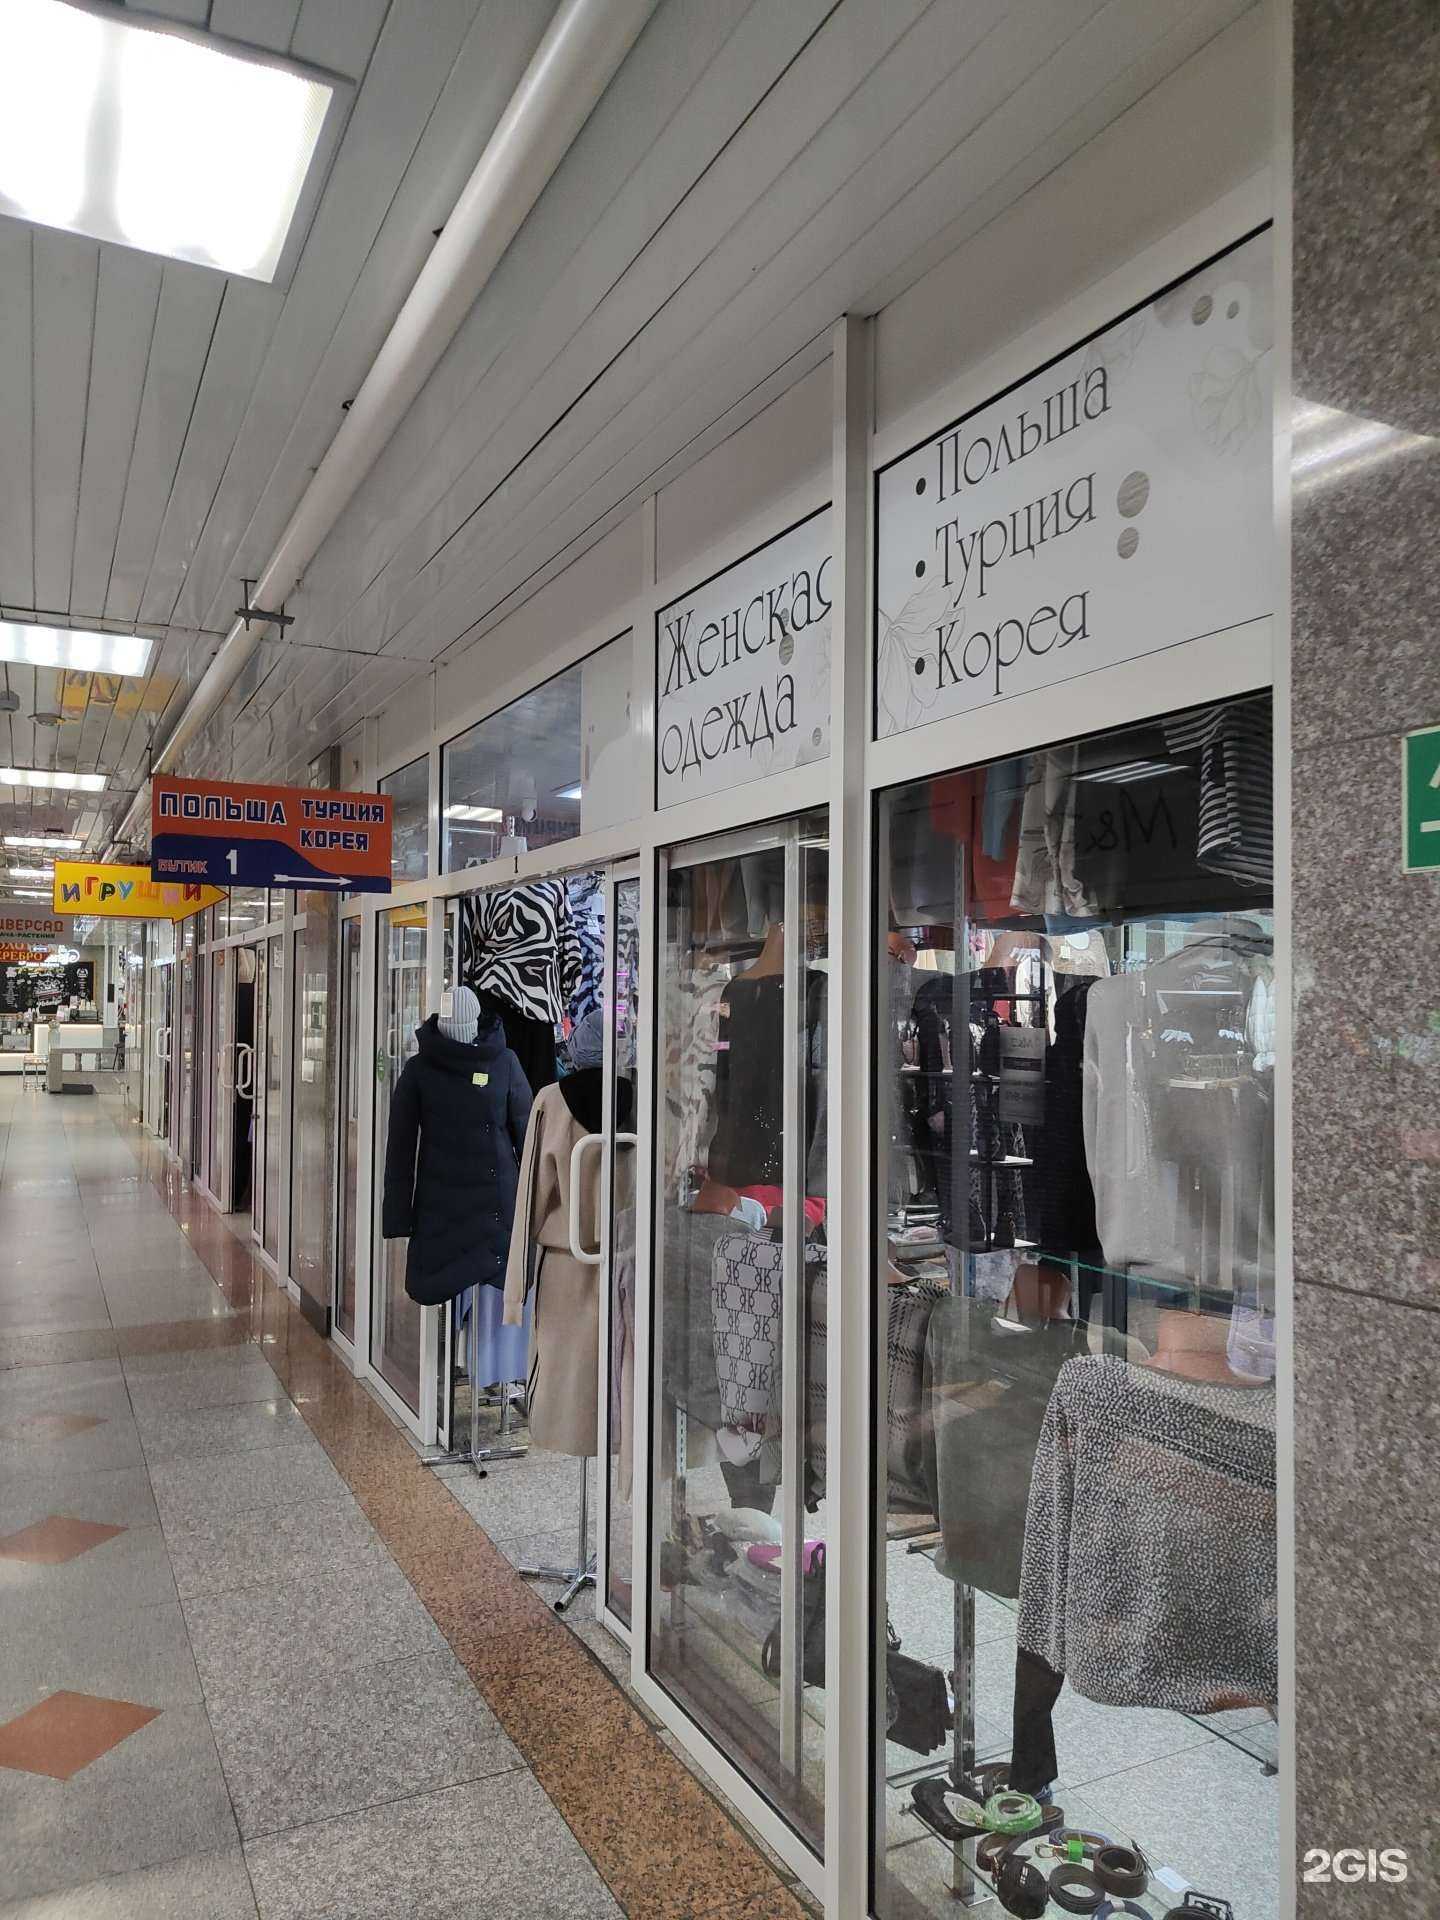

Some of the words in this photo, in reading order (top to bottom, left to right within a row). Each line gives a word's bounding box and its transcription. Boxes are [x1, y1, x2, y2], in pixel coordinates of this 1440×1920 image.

[936, 366, 1112, 504] Польша
[935, 472, 1097, 606] Турция
[935, 590, 1092, 695] Корея
[660, 672, 797, 782] одежда
[159, 791, 287, 826] ПОЛЬША
[300, 798, 385, 823] ТУРЦИЯ
[299, 828, 369, 852] КОРЕЯ
[157, 858, 208, 874] БУТИК
[225, 849, 239, 875] 1
